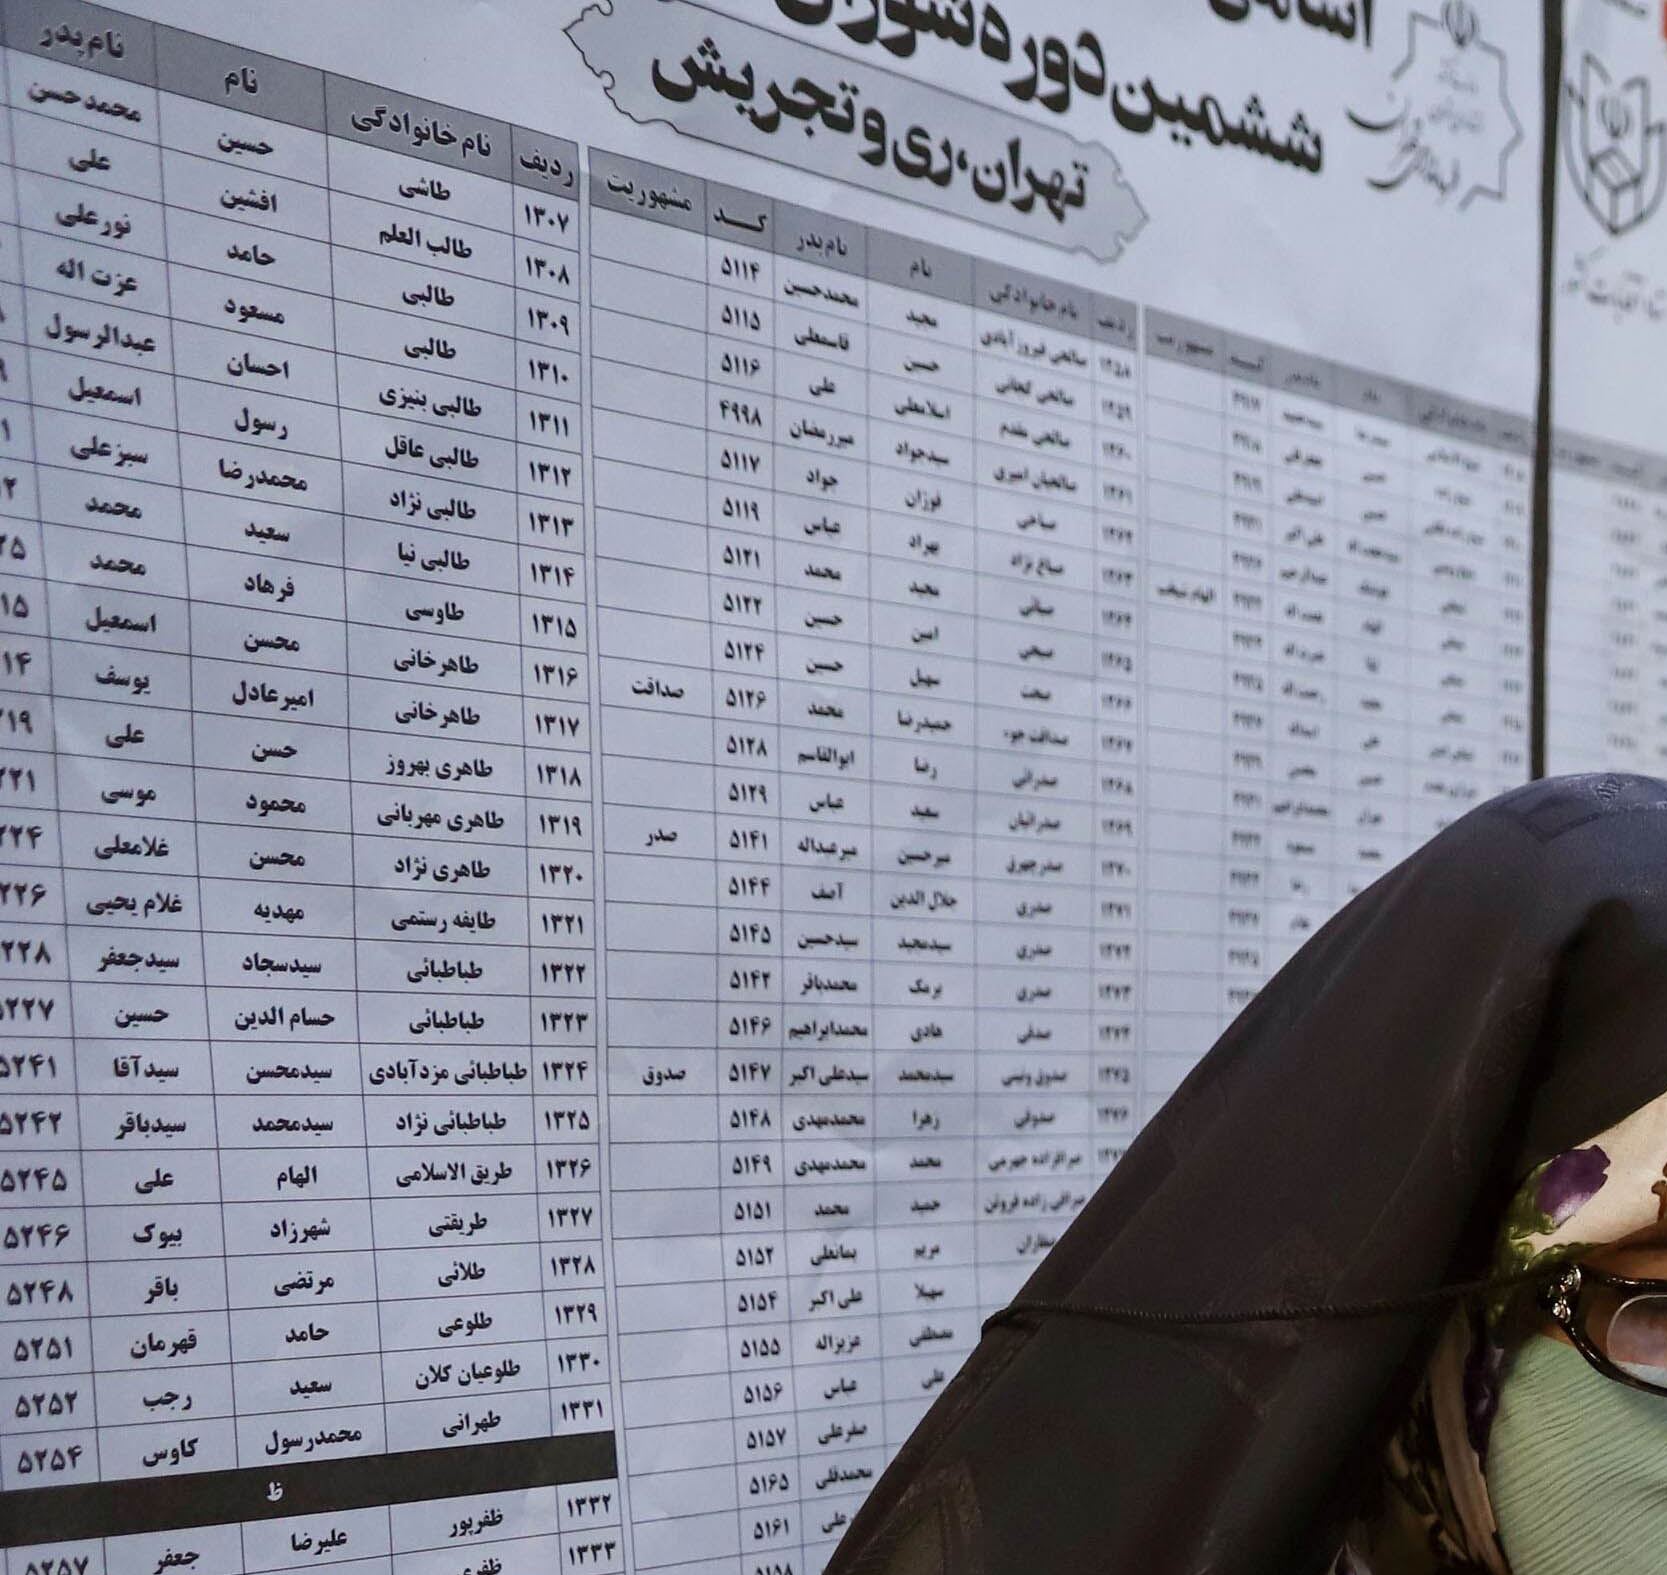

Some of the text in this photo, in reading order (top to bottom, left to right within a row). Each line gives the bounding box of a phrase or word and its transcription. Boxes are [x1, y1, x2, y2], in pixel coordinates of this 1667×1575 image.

[980, 14, 1105, 113] دوره
[651, 35, 858, 137] تجریش
[224, 67, 575, 189] ردیف نام خانوادگی نام
[862, 106, 890, 164] و
[1111, 75, 1326, 173] ششمین
[27, 82, 570, 234] ۱۳۰۷ طاشی حسین محمدحسن
[891, 121, 954, 187] ری
[607, 174, 692, 212] مشهوریت
[226, 244, 277, 266] حامد
[720, 255, 760, 282] ۵۱۱۴
[401, 283, 456, 308] طالبی
[44, 312, 157, 357] عبدالرسول
[527, 306, 570, 337] ۱۳۰۹
[226, 352, 290, 380] احسان
[529, 409, 569, 438] ۱۳۱۱
[719, 399, 763, 428] ۴۹۹۸
[722, 496, 760, 522] ۵۱۱۹
[89, 554, 578, 639] ۱۳۱۵ طاوسی فرهاد محمد
[722, 592, 762, 616] ۵۱۲۲
[631, 676, 685, 699] صداقت
[725, 687, 767, 709] ۵۱۲۶
[807, 703, 845, 719] محمد
[100, 788, 583, 837] ۱۳۱۹ طاهری مهربانی محمود موسی
[644, 828, 679, 847] صدر
[728, 829, 768, 850] ۵۱۴۱
[729, 923, 772, 945] ۵۱۴۵
[728, 1015, 772, 1036] ۵۱۴۶
[542, 1060, 589, 1082] ۱۳۲۴
[642, 1065, 687, 1087] صدوق
[728, 1062, 772, 1083] ۵۱۴۷
[0, 1157, 592, 1195] ۱۳۲۶ طریق الاسلامی الهام علی ۵۲۴۵
[735, 1246, 775, 1267] ۵۱۵۲
[6, 1254, 596, 1307] ۱۳۲۸ طلائی مرتضی باقر ۵۲۴۸
[740, 1337, 782, 1359] ۵۱۵۵
[17, 1398, 604, 1475] ۱۳۳۱ طهرانی محمدرسول کاوس ۵۲۵۴
[746, 1427, 787, 1450] ۵۱۵۷
[267, 1482, 283, 1501] ظ
[568, 1540, 617, 1566] ۱۳۳۳
